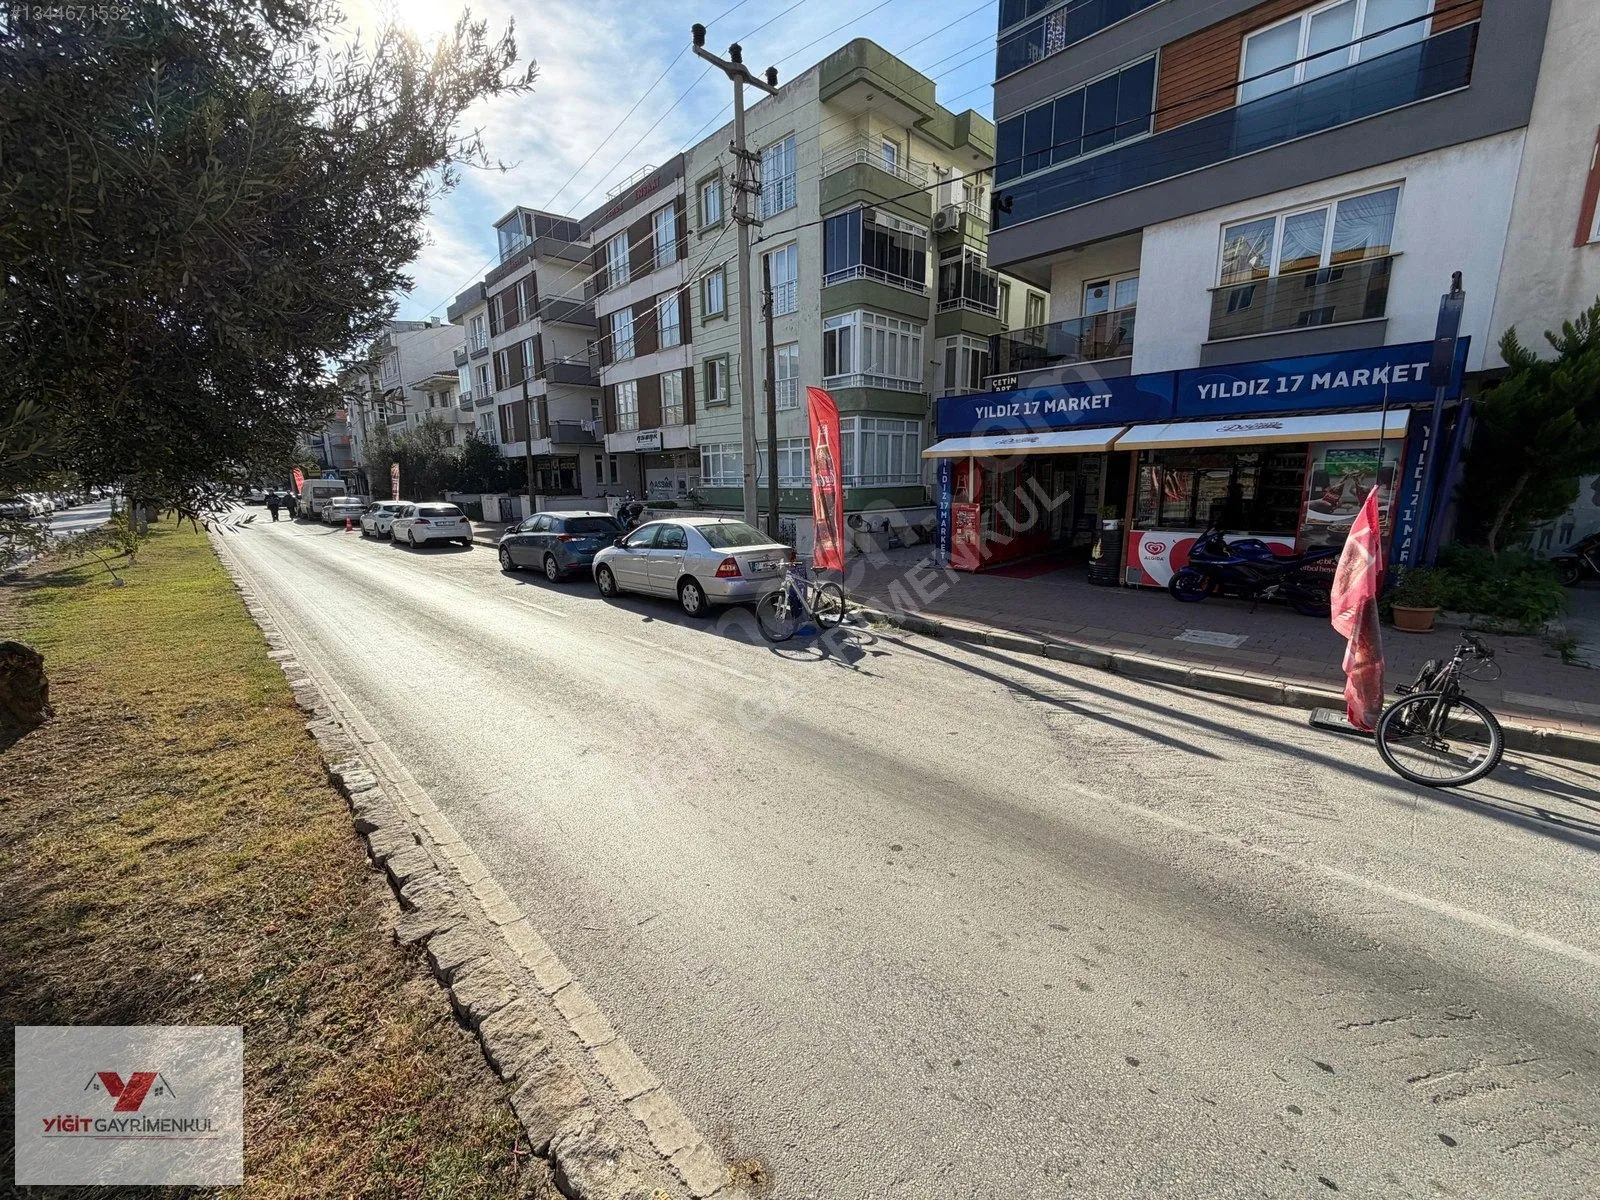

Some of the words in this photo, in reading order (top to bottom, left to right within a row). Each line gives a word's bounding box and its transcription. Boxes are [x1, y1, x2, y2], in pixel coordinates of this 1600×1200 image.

[992, 375, 1017, 388] ÇETİN
[1197, 378, 1269, 400] YILDIZ
[1276, 374, 1304, 394] 17
[1311, 362, 1430, 390] MARKET
[975, 403, 1020, 420] YILDIZ
[1023, 401, 1041, 416] 17
[1044, 393, 1113, 414] MARKET
[941, 457, 949, 499] ILDIZ
[940, 512, 948, 560] MARKET
